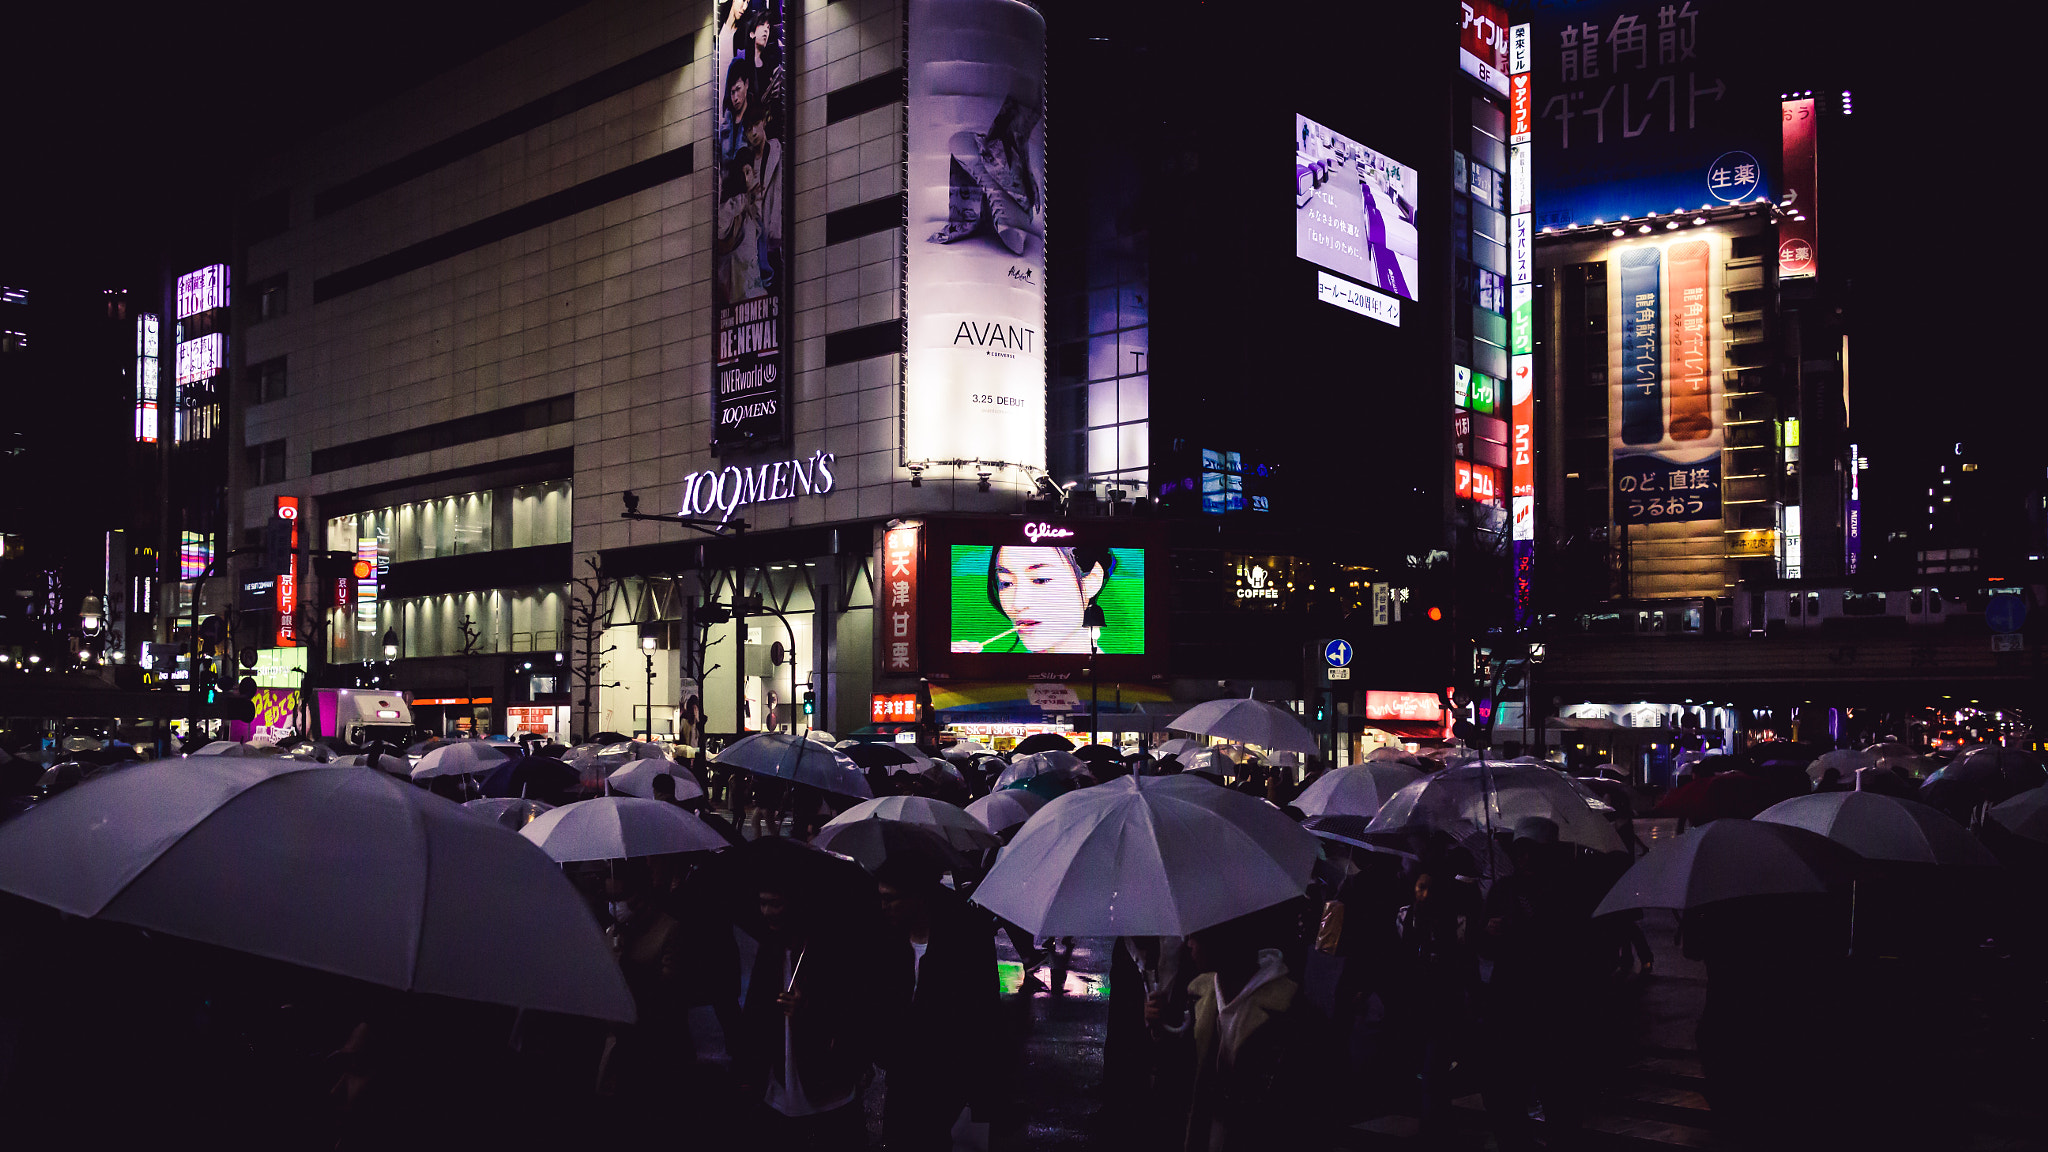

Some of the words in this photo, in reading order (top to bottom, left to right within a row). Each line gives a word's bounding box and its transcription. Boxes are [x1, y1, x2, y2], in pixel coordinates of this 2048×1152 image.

[1461, 1, 1507, 55] アイフル
[1560, 1, 1699, 82] 龍角散
[1479, 62, 1491, 82] 8F
[1515, 87, 1527, 134] アイフル
[1541, 71, 1726, 149] ダイレクト
[1711, 163, 1756, 188] 生薬
[1308, 186, 1338, 208] すべては、
[1308, 208, 1360, 239] みなさまの快適な
[1307, 227, 1363, 260] 「ねむり」のために。
[1516, 218, 1527, 281] レオパレス21
[1780, 247, 1810, 262] 生薬
[735, 296, 779, 325] 109MEN'S
[720, 319, 779, 359] RE:NEWAL
[953, 321, 1035, 353] AVANT
[1515, 310, 1529, 349] レイク
[1636, 292, 1655, 395] 龍角散ダイレクト
[1683, 287, 1704, 391] 龍角散ダイレクト
[720, 363, 763, 395] UVERworld
[1472, 382, 1493, 404] レイク
[720, 399, 777, 429] 109MEN'S
[972, 394, 993, 404] 3.25
[996, 396, 1025, 408] DEBUT
[1515, 424, 1530, 465] アコム
[678, 449, 835, 530] 109MEN'S
[1459, 469, 1494, 497] アコム
[1619, 467, 1718, 493] のど、直接、
[1628, 495, 1704, 517] うるおう
[1024, 522, 1074, 543] Glico
[1787, 538, 1799, 547] 3F
[1236, 588, 1279, 599] COFFEE
[891, 551, 910, 668] 天津甘栗
[874, 700, 914, 715] 天津甘栗
